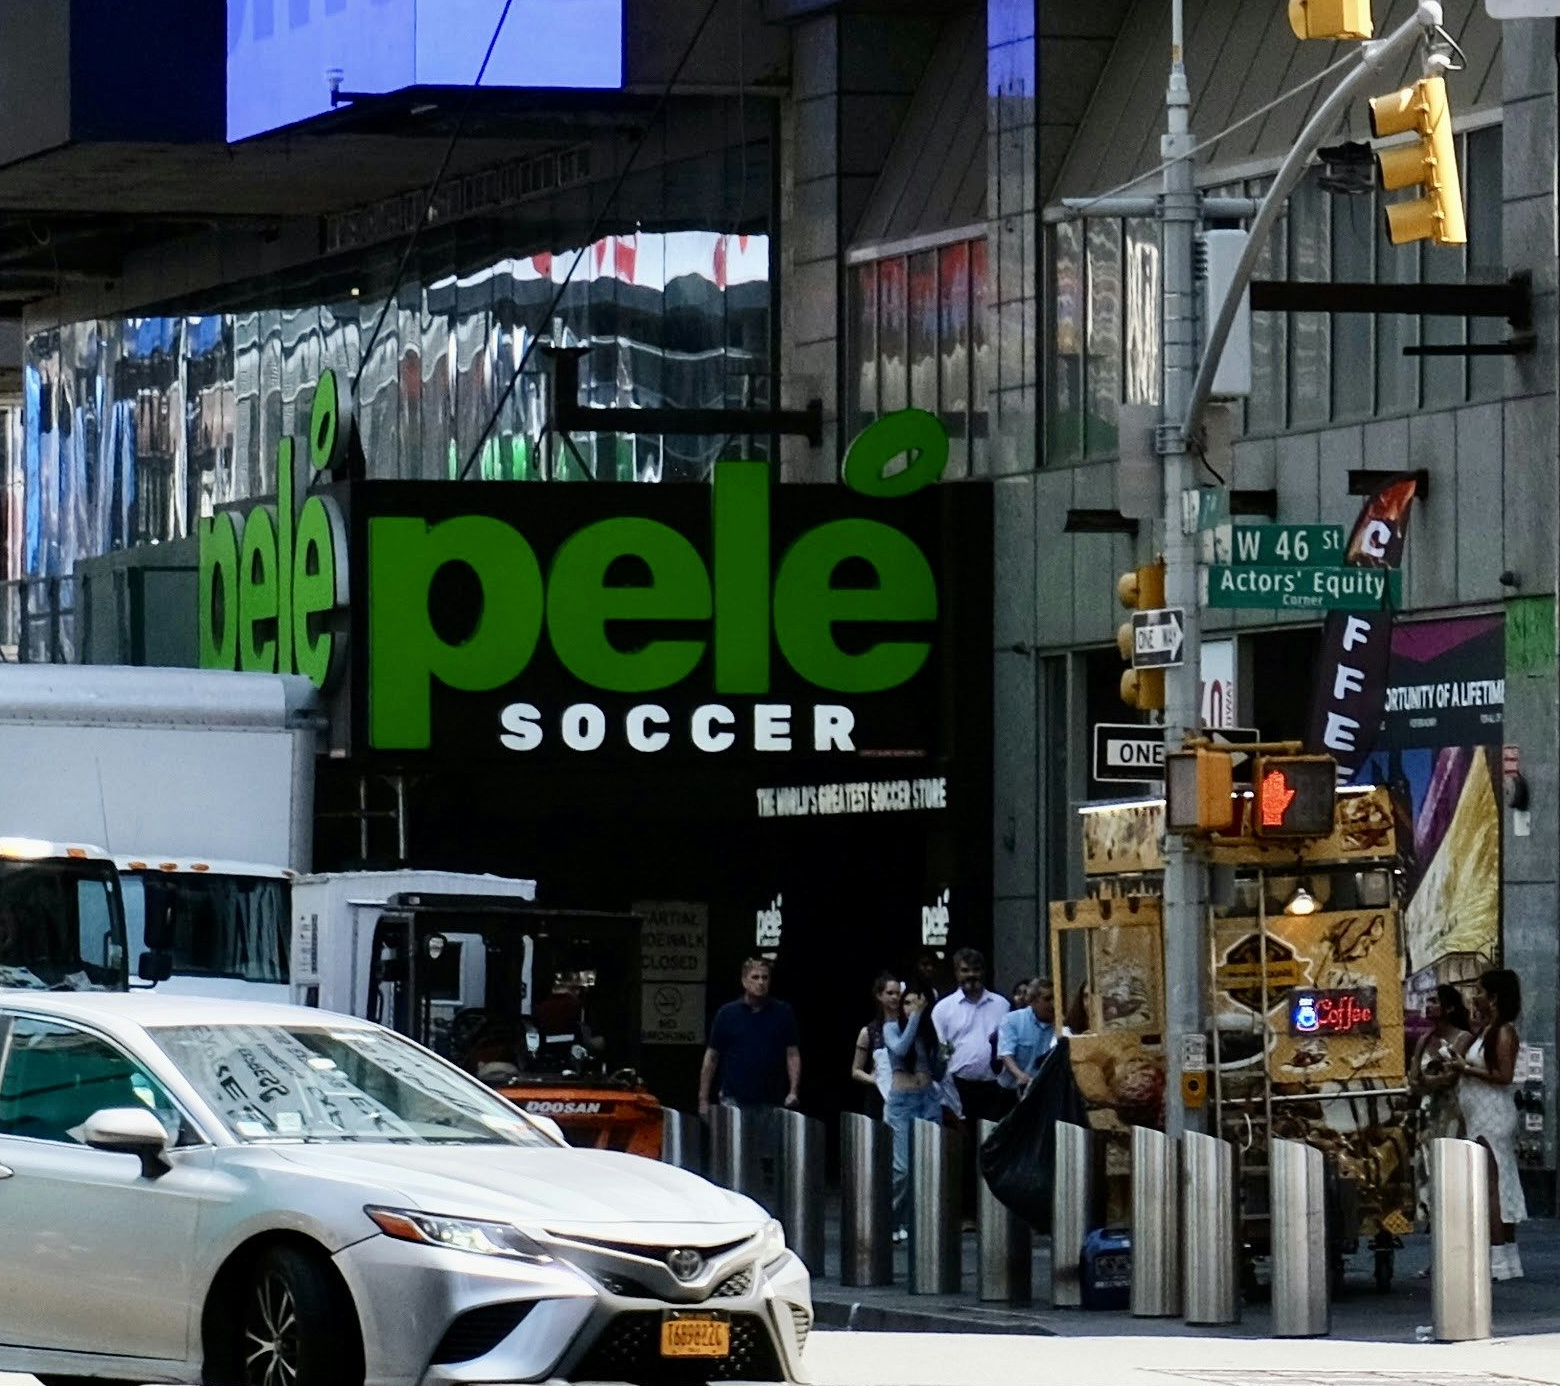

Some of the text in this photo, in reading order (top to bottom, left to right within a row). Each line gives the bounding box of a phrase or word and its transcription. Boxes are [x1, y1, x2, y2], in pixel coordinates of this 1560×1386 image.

[1237, 529, 1340, 562] W 46 St
[369, 407, 950, 751] pelé
[1220, 570, 1386, 600] Actors' Equity
[1282, 594, 1324, 607] Corner
[1323, 519, 1392, 786] CFFE
[1436, 683, 1449, 710] OF
[499, 701, 857, 754] SOCCER
[1119, 743, 1165, 764] ONE
[756, 787, 776, 818] THE
[818, 781, 870, 815] GREATEST
[871, 779, 912, 813] SOCCER
[912, 777, 947, 810] STORE
[646, 910, 698, 927] ARTIAL
[1316, 996, 1373, 1032] Coffee
[525, 1101, 601, 1114] DOOSAN
